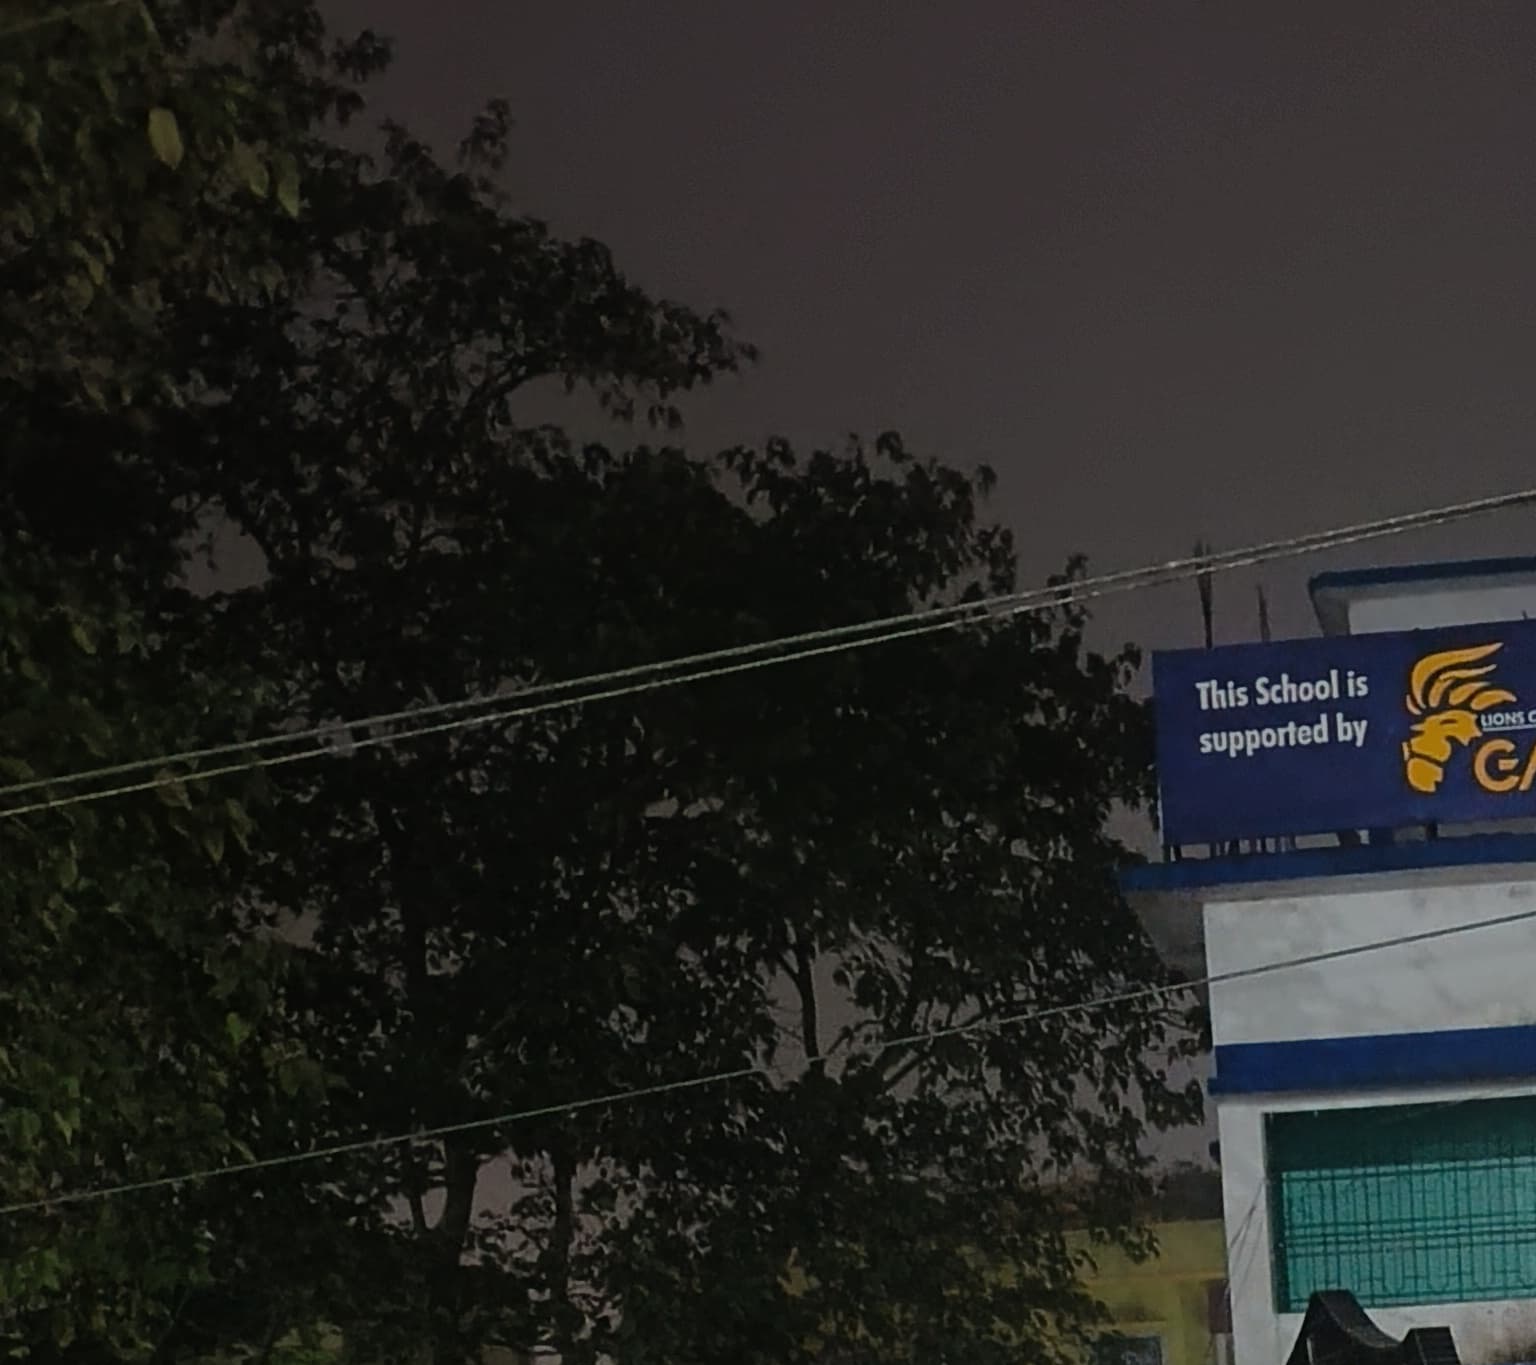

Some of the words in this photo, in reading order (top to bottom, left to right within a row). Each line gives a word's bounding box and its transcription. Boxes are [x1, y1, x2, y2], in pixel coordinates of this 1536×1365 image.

[1195, 679, 1249, 711] This
[1255, 669, 1340, 706] School
[1346, 670, 1369, 698] is
[1199, 713, 1329, 758] supported
[1336, 712, 1368, 748] by
[1480, 711, 1525, 728] LIONS
